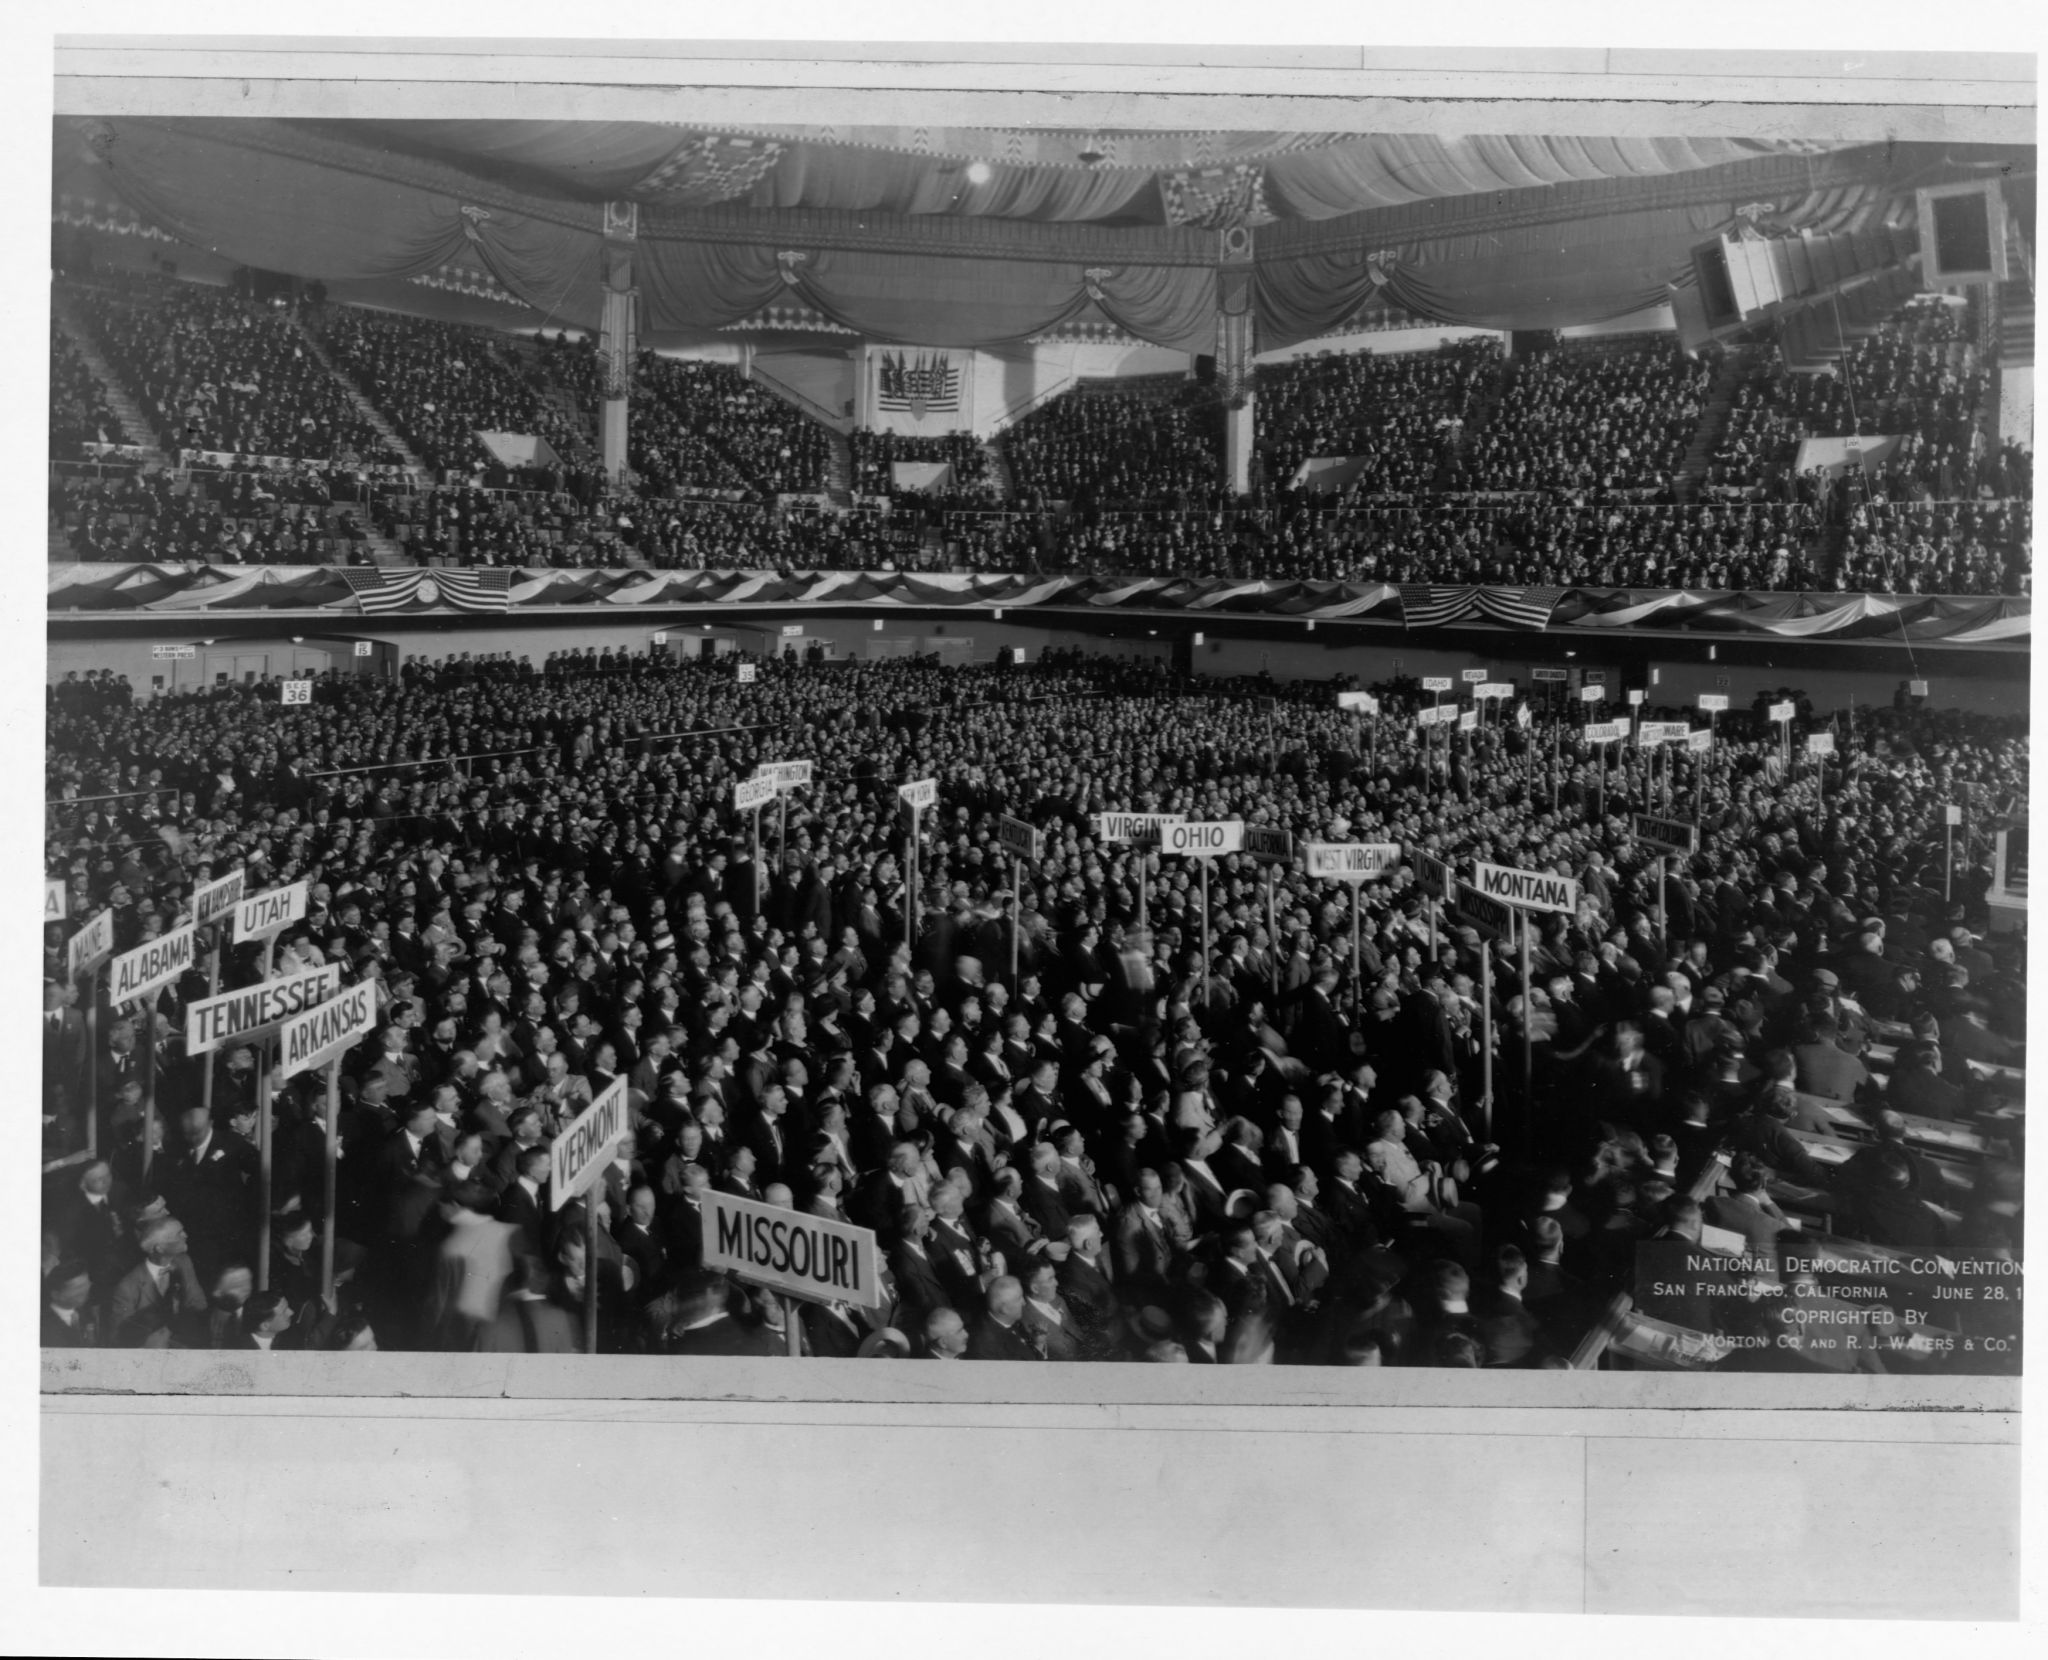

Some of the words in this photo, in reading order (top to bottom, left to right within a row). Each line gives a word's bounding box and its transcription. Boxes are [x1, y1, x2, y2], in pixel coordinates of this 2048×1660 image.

[287, 690, 308, 703] 36
[1425, 679, 1448, 688] IDAHO
[740, 779, 773, 805] GEORGIA
[1172, 826, 1225, 849] OHIO
[1483, 868, 1570, 908] MONTANA
[244, 891, 291, 932] UTAH
[75, 922, 102, 967] MAINE
[117, 933, 190, 996] ALABAMA
[288, 989, 367, 1066] ARKANSAS
[558, 1086, 622, 1189] VERMONT
[716, 1205, 861, 1291] MISSOURI
